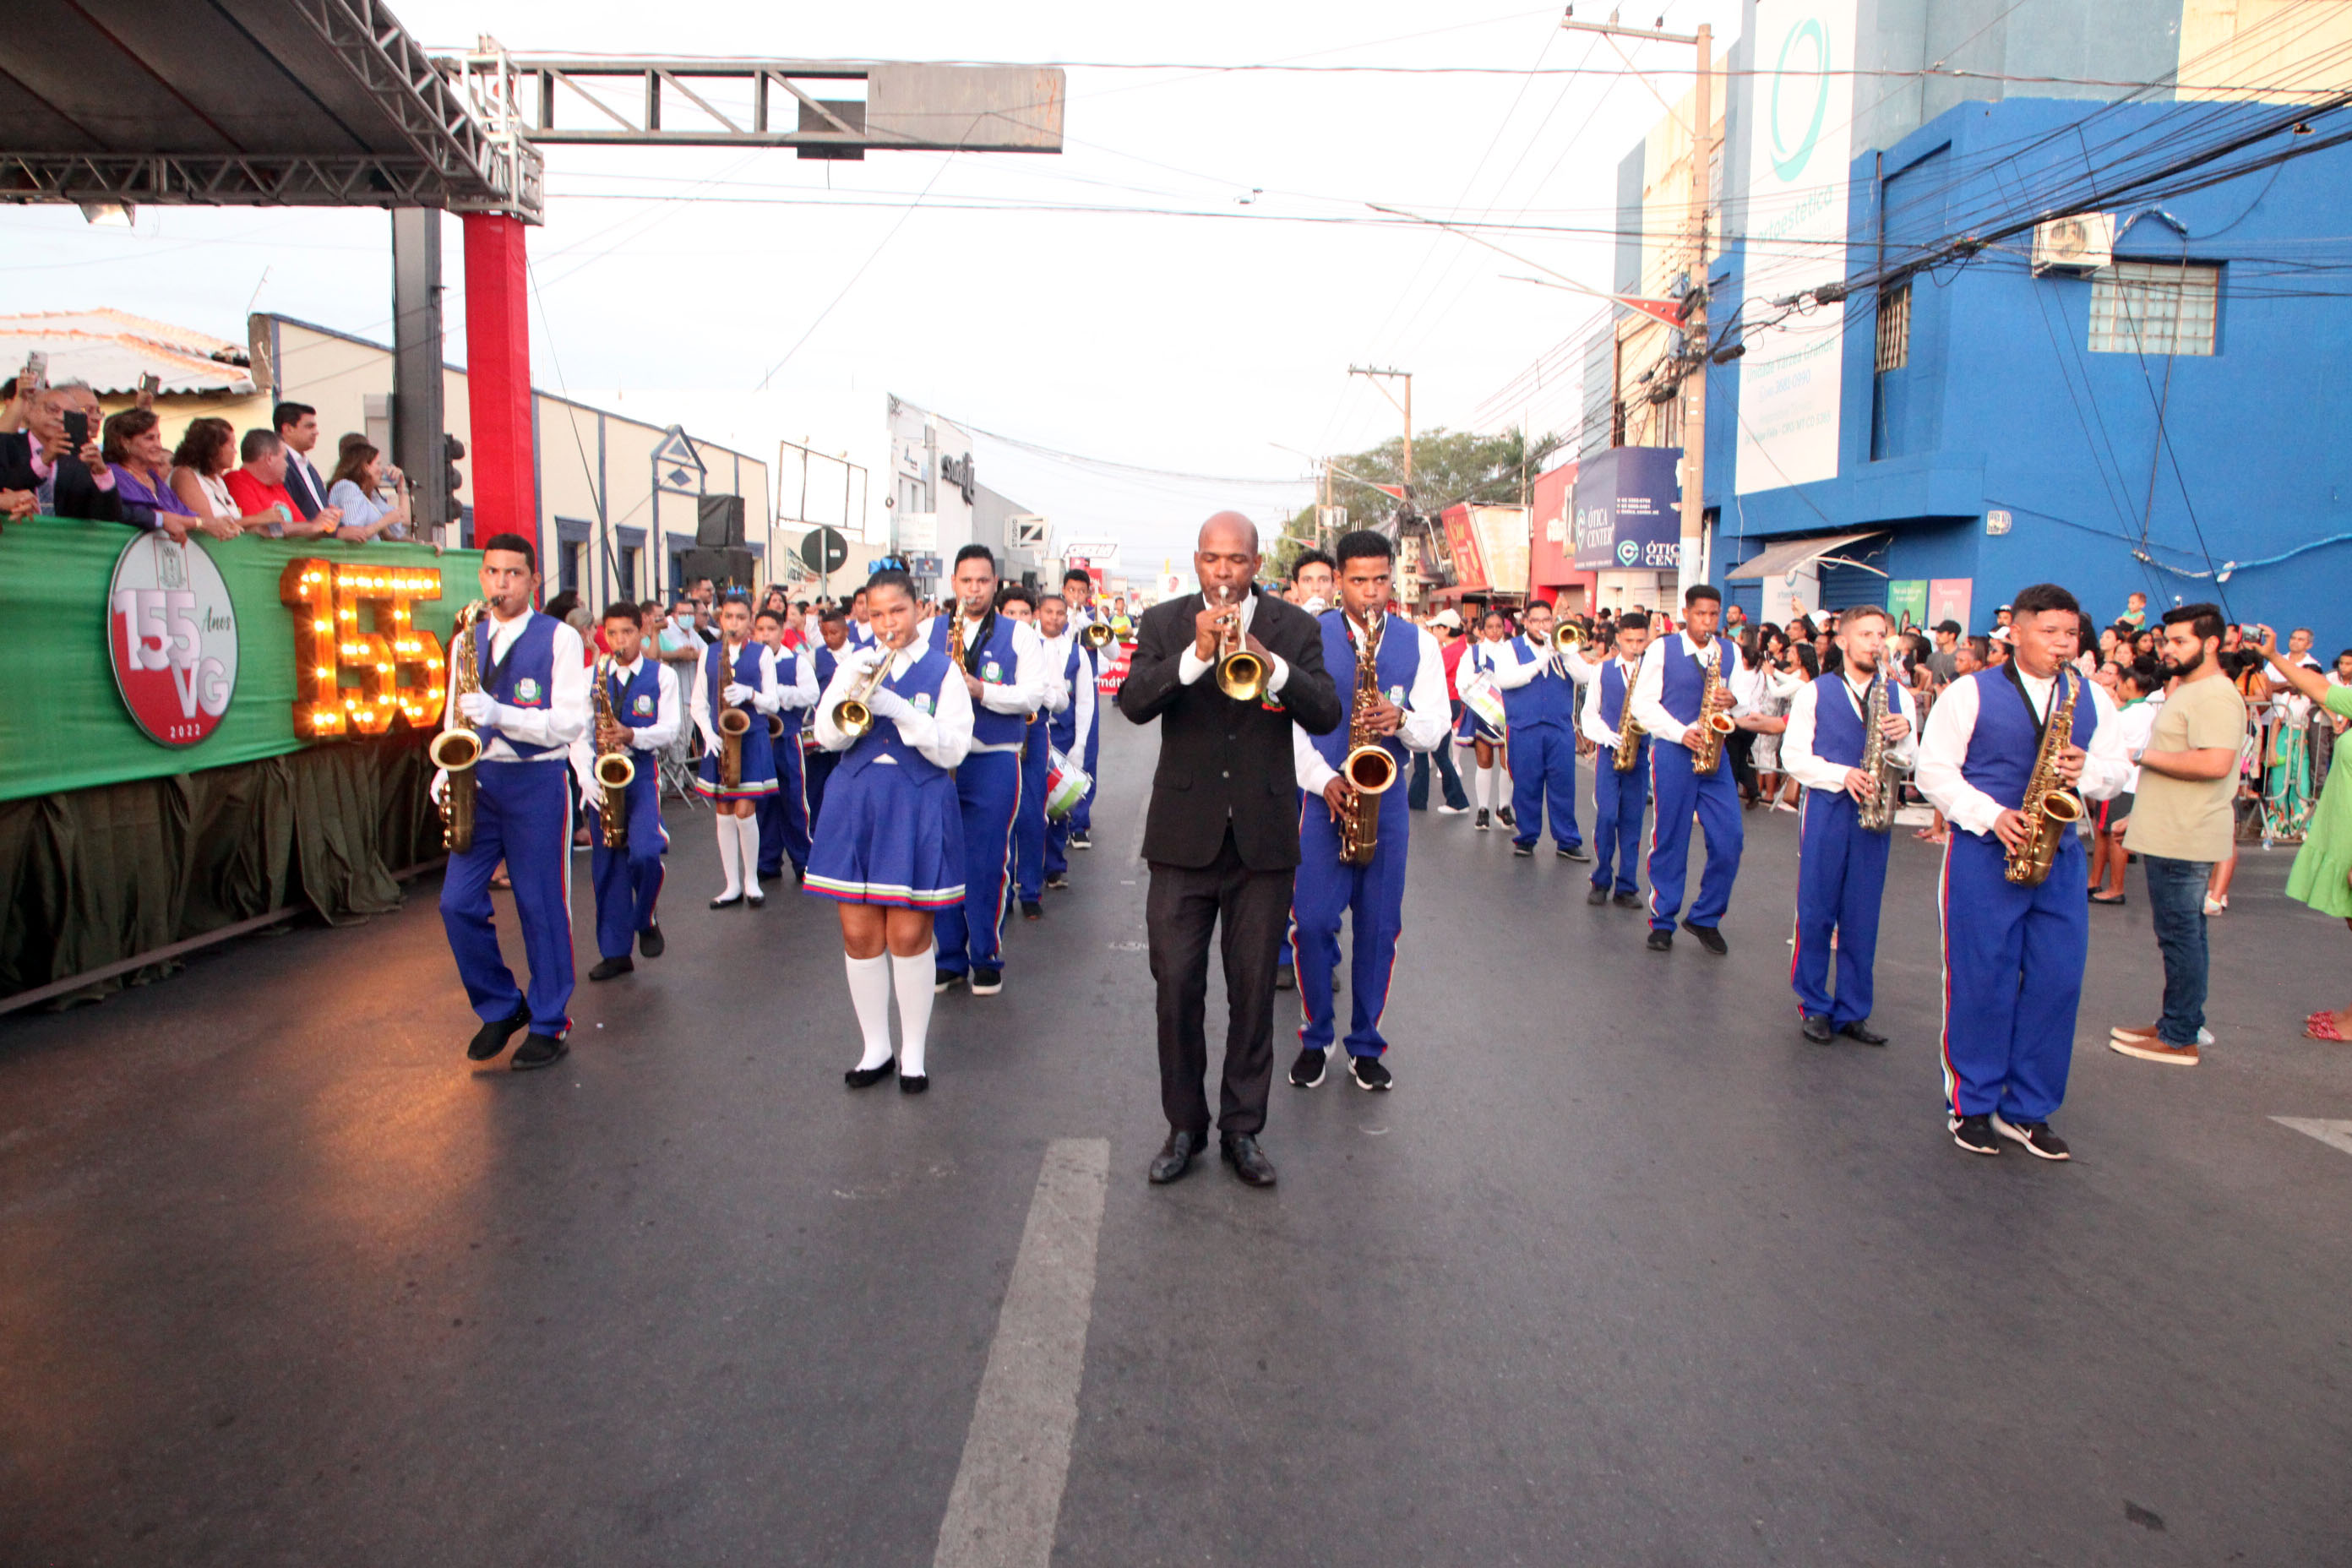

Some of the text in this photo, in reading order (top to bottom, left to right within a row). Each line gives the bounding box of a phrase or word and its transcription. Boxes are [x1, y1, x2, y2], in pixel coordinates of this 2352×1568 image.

[1588, 505, 1608, 528] ÓTICA
[1587, 525, 1613, 548] CENTER
[113, 589, 202, 670] 155
[201, 606, 231, 633] Anos
[280, 558, 445, 738] 155
[172, 656, 230, 718] VG
[170, 724, 200, 738] 2022
